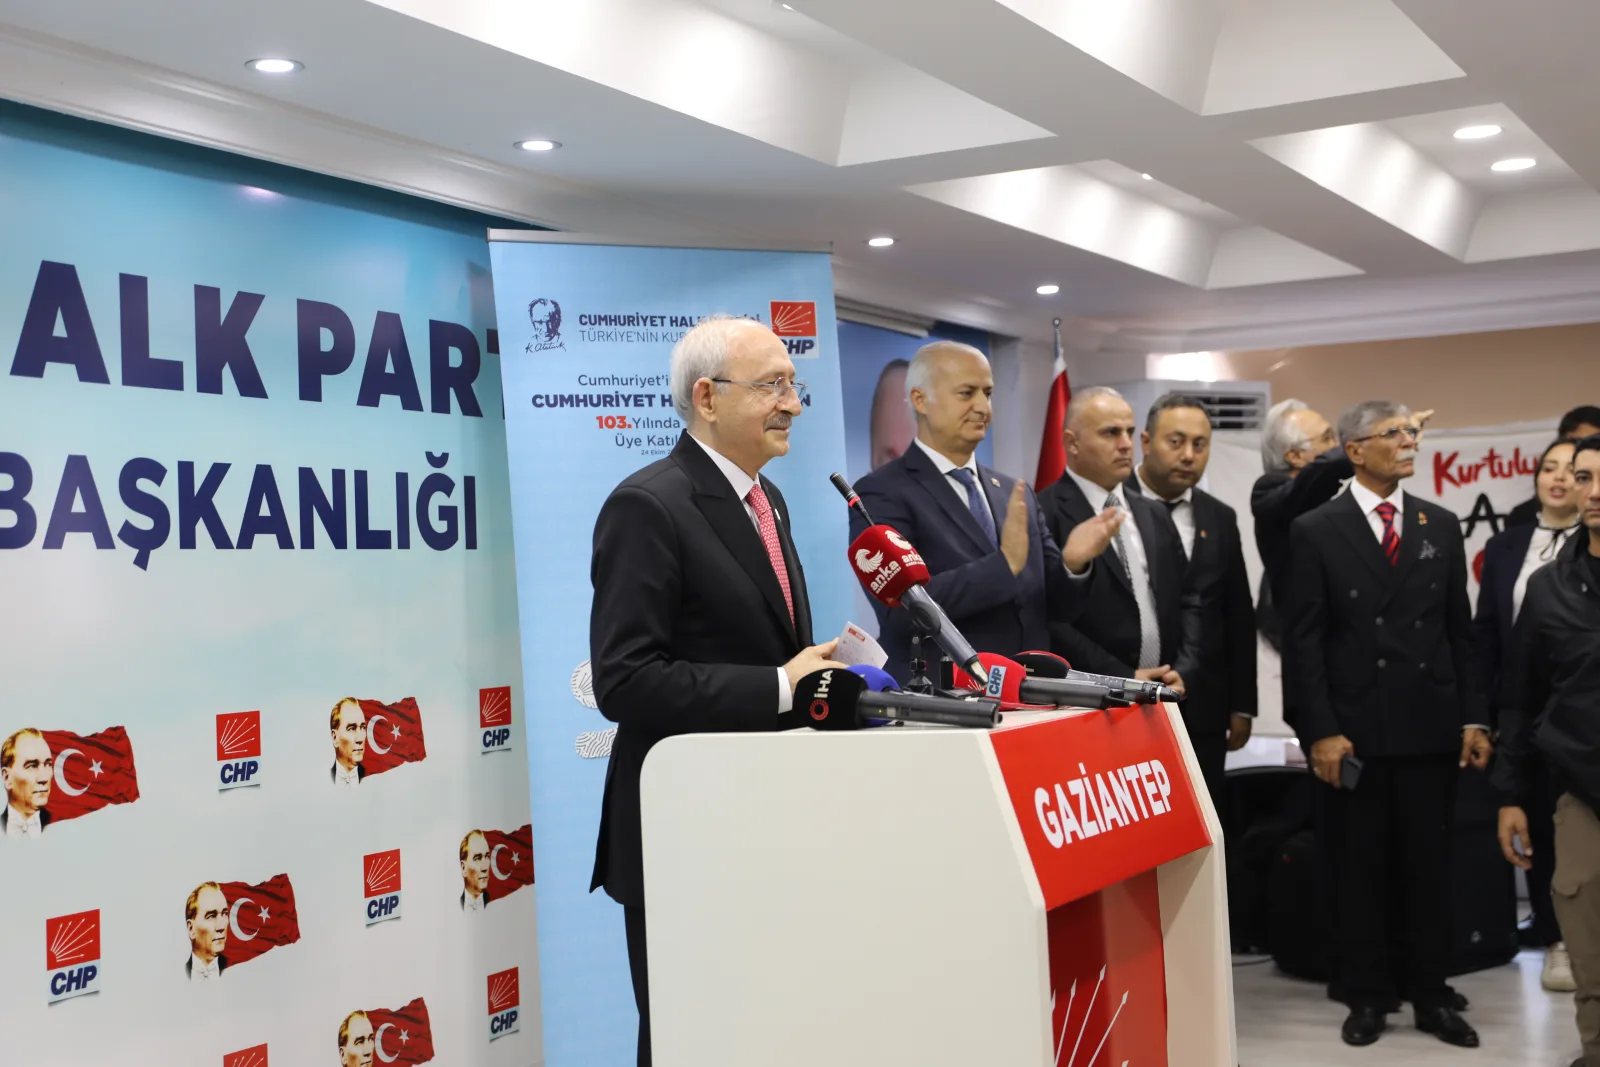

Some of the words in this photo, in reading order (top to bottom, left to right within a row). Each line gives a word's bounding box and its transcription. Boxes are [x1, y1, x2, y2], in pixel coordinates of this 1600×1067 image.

[10, 260, 269, 399] ALK
[579, 312, 667, 327] CUMHURİYET
[579, 328, 658, 343] TÜRKİYE'NİN
[781, 339, 814, 354] HP
[578, 374, 671, 389] Cumhuriyet'i
[531, 391, 655, 408] CUMHURİYET
[615, 433, 642, 449] Üye
[0, 451, 478, 571] BAŞKANLIĞI
[870, 560, 900, 592] anka
[988, 667, 1003, 695] CHP
[482, 728, 510, 748] CHP
[220, 760, 259, 784] CHP
[1034, 759, 1172, 849] GAZİANTEP
[367, 895, 400, 919] CHP
[50, 964, 98, 996] CHP
[490, 1009, 518, 1035] CHP
